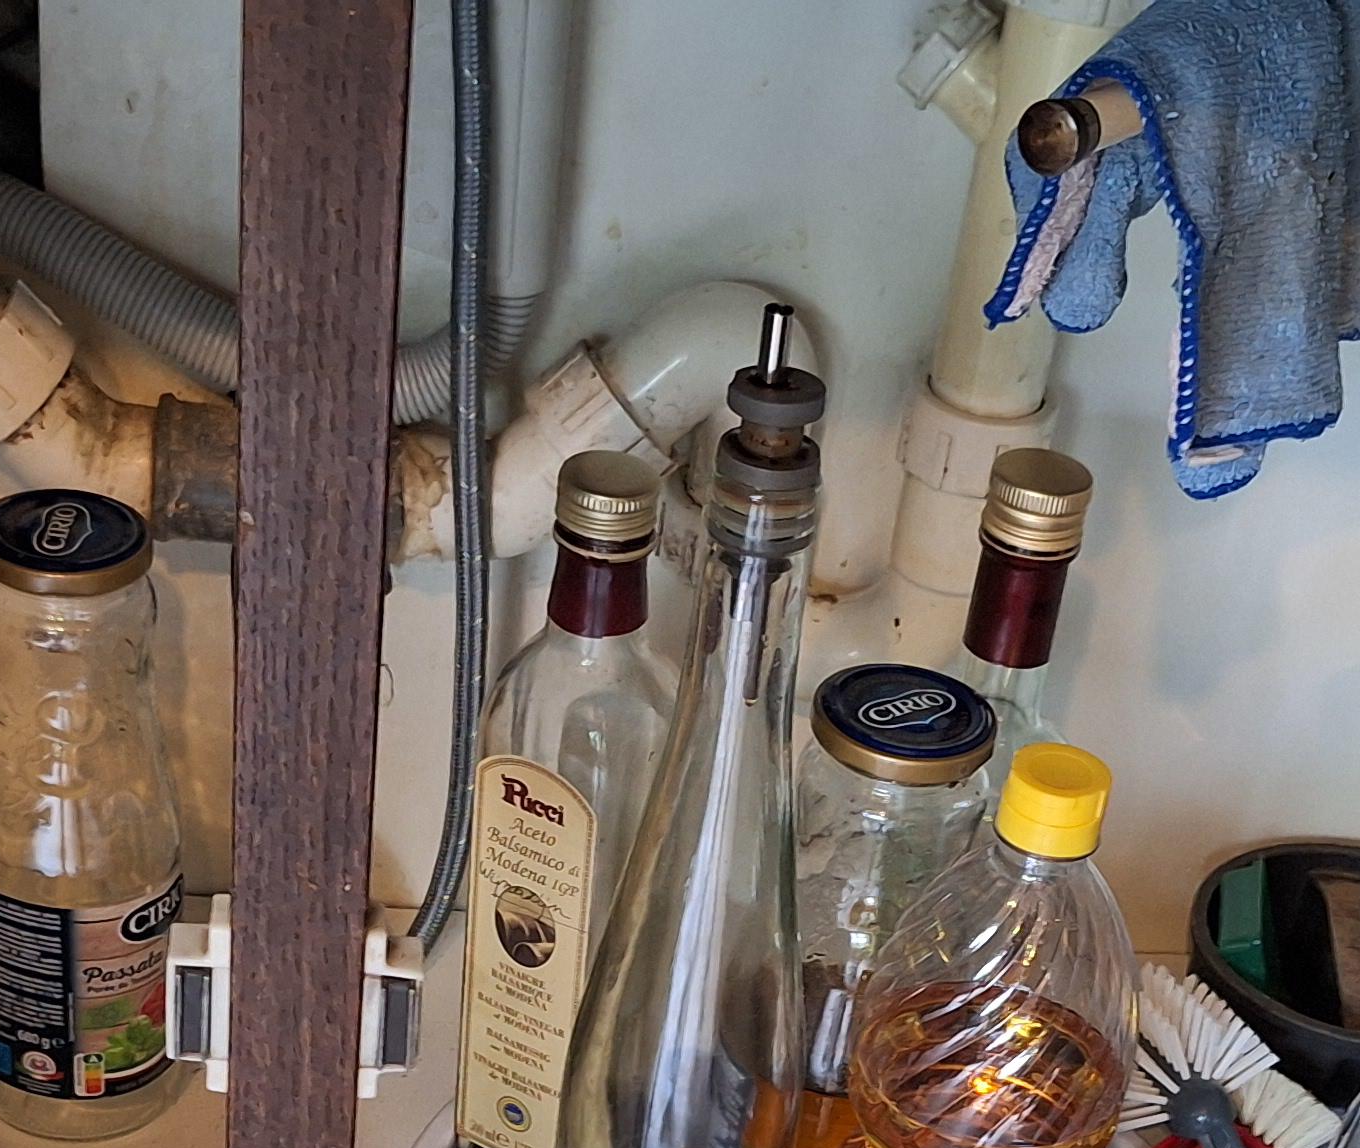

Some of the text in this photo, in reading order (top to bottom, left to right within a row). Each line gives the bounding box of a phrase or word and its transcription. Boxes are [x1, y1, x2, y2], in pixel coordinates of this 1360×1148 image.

[43, 508, 78, 552] CIRIO
[868, 692, 945, 723] CIRIO
[487, 826, 581, 879] Balsamico di
[510, 817, 557, 847] Aceto
[486, 846, 549, 888] Modena
